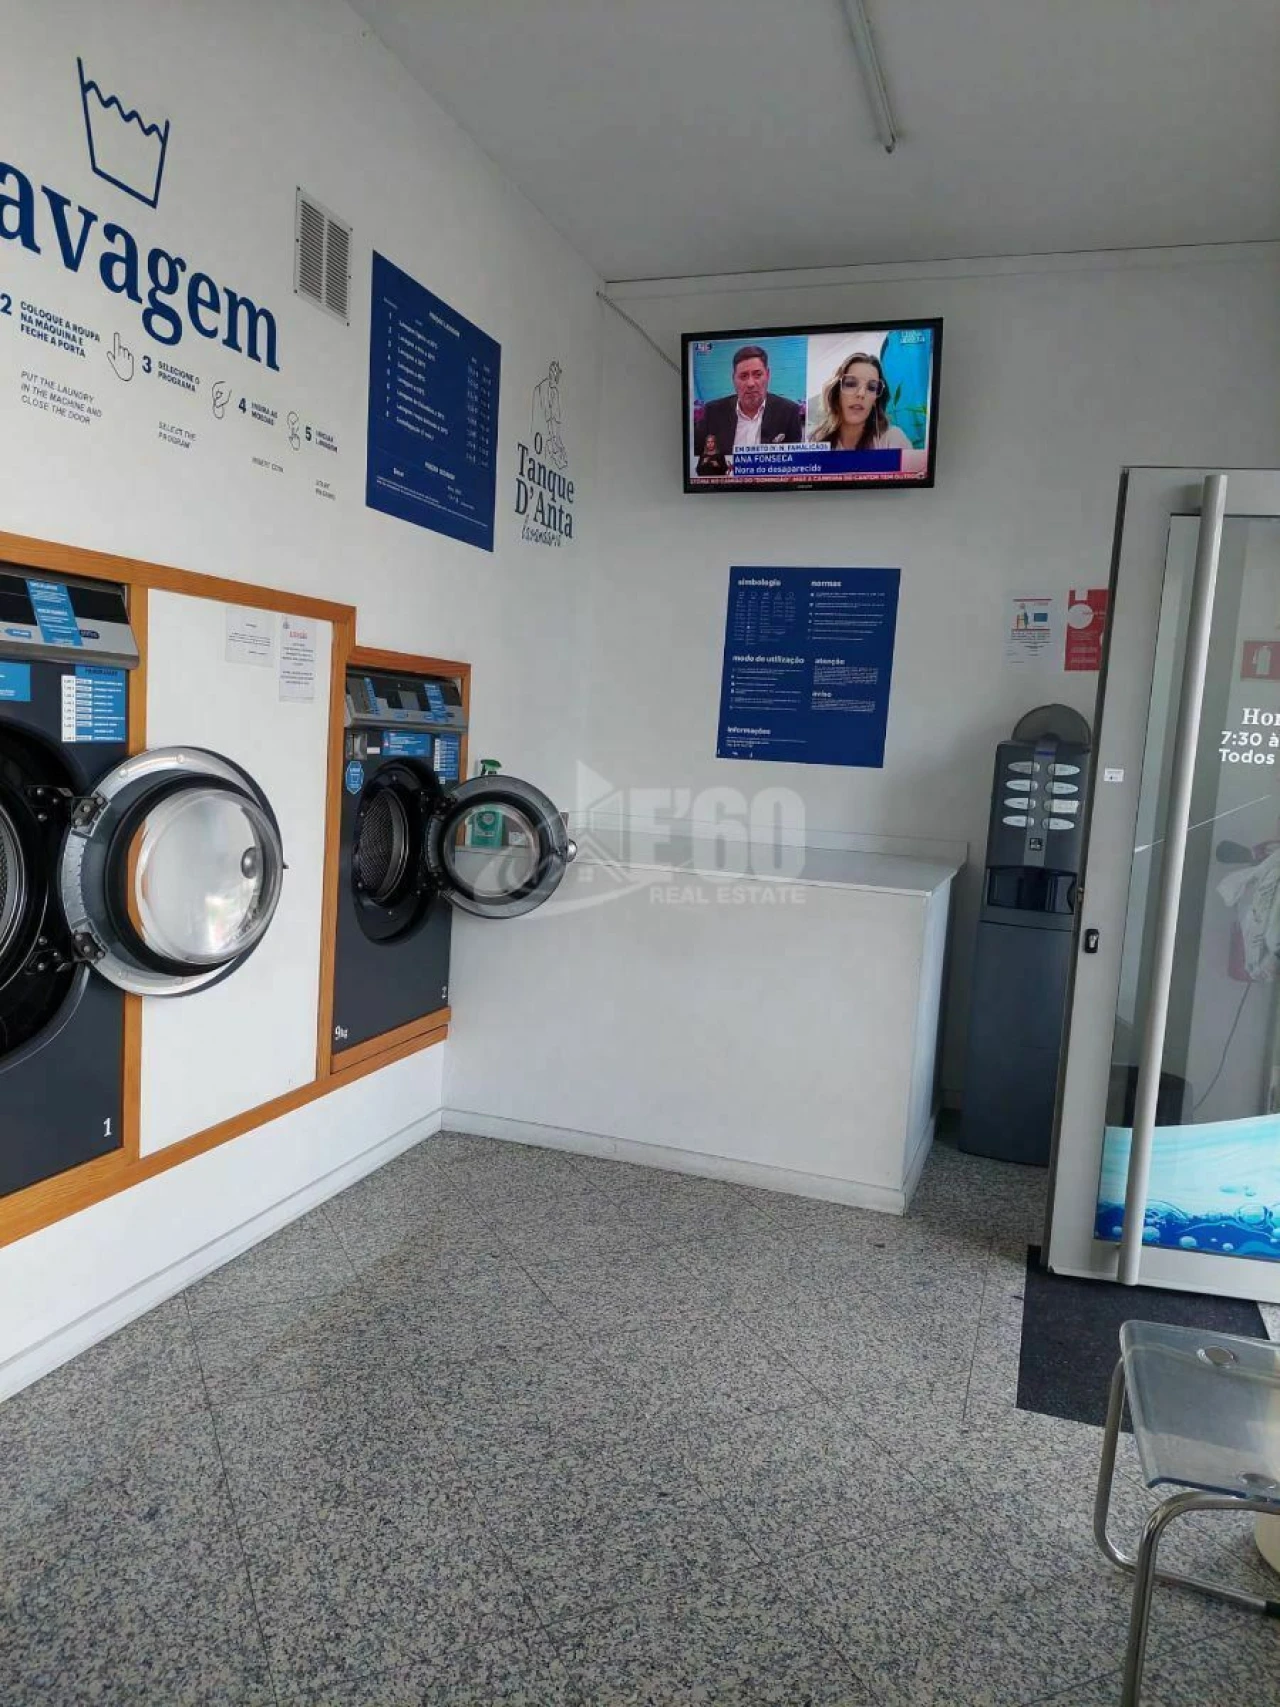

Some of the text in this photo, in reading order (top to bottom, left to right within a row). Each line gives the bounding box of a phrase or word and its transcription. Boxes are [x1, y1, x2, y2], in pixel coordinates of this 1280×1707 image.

[0, 161, 280, 372] avagem
[0, 293, 12, 316] 2
[20, 301, 100, 343] COLOQUE A ROUPA
[21, 312, 33, 324] NA
[79, 337, 84, 346] E
[21, 324, 86, 358] FECHE A PORTA
[142, 355, 152, 373] 3
[21, 370, 94, 404] PUT THE LAUNDRY
[21, 383, 30, 392] IN
[33, 386, 47, 399] THE
[50, 393, 85, 411] MACHINE
[21, 395, 90, 424] CLOSE THE DOOR
[238, 397, 247, 414] 4
[305, 425, 312, 441] 5
[534, 431, 543, 455] O
[734, 453, 793, 463] ANA FONSECA
[517, 441, 575, 503] Tanque
[734, 466, 754, 474] Nora
[767, 463, 822, 476] desaparecido
[514, 477, 573, 539] D'Anta
[737, 578, 782, 587] simbologia
[732, 654, 805, 665] modo de utilização
[814, 658, 845, 666] atenção
[727, 726, 771, 736] informações
[1221, 730, 1263, 747] 7:30
[1219, 748, 1275, 765] Todos
[103, 1117, 112, 1138] 1
